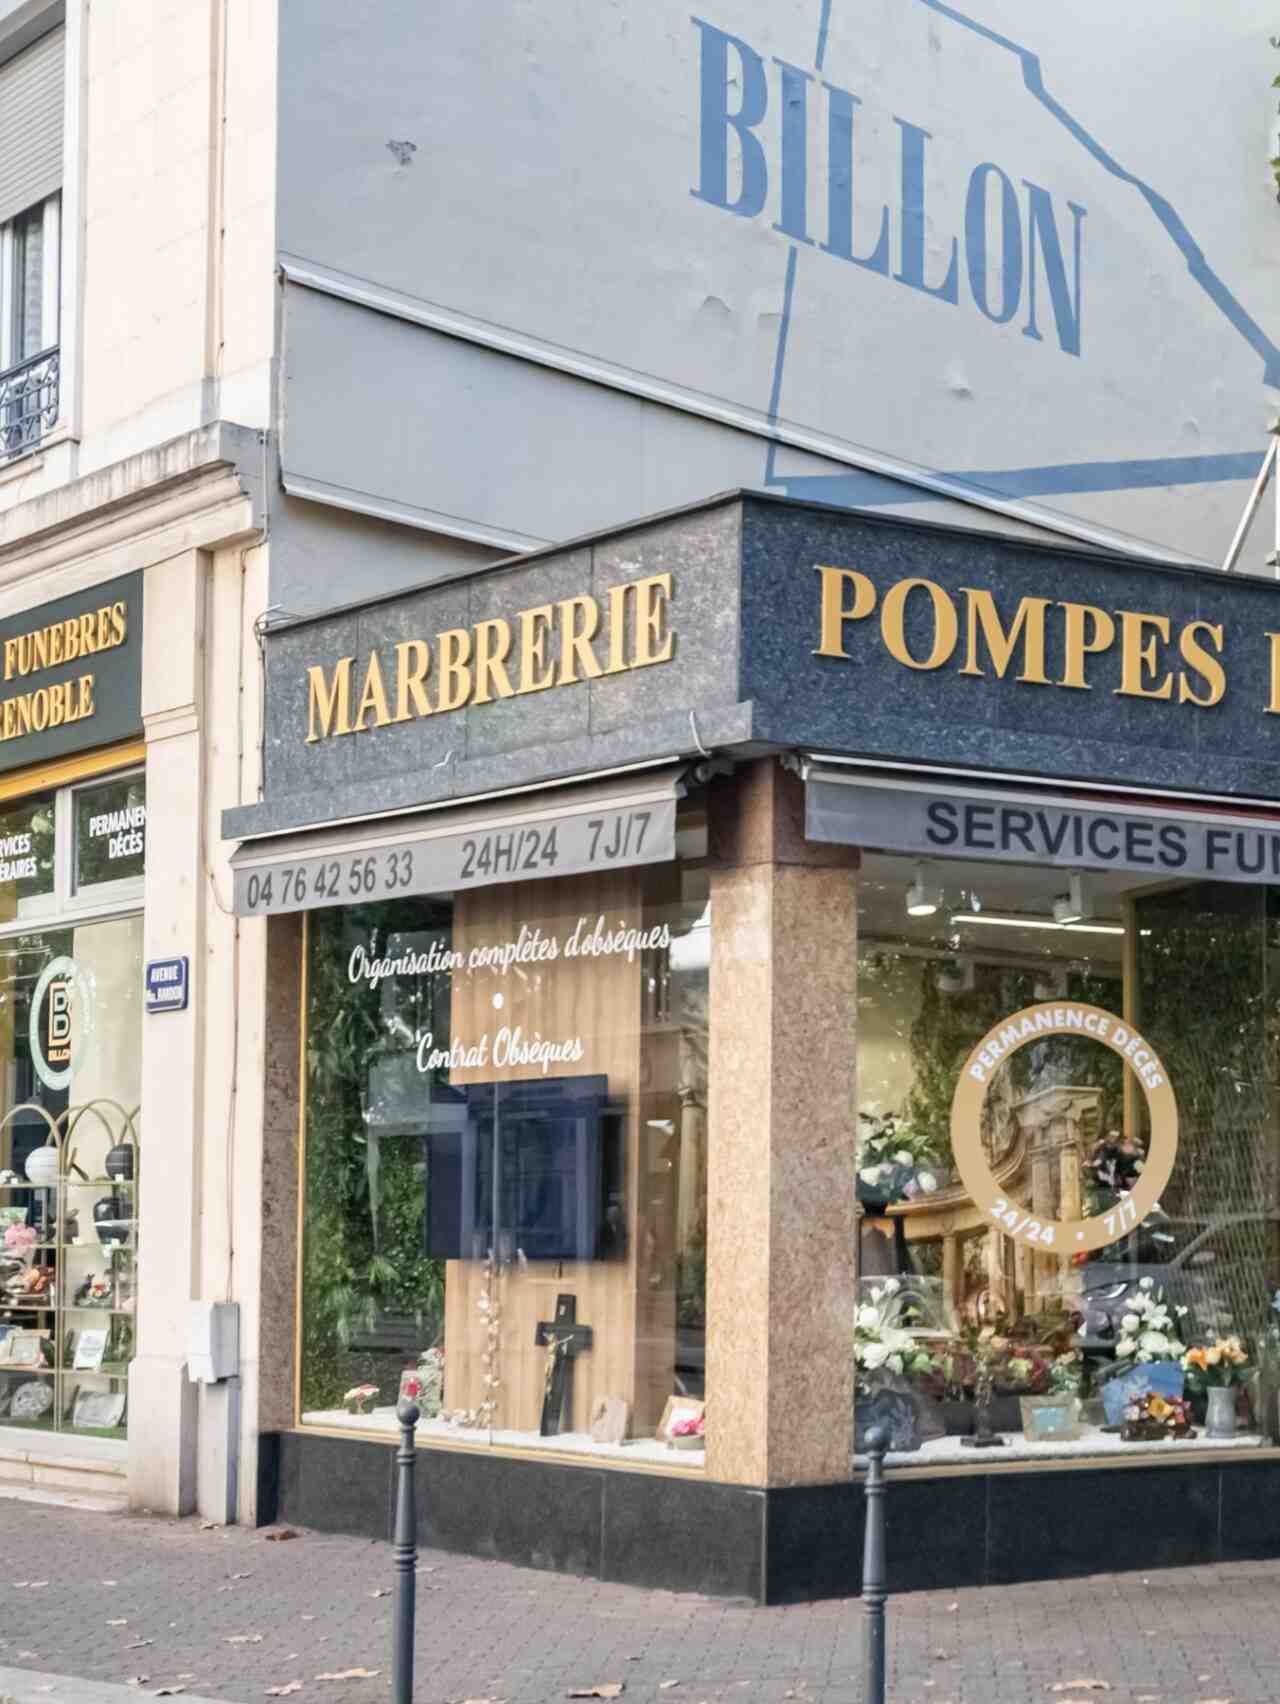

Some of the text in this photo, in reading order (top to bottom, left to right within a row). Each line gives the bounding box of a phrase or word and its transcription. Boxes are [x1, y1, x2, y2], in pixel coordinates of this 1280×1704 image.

[690, 16, 1087, 358] BILLON
[4, 601, 127, 681] FUNEBRES
[304, 573, 674, 744] MARBRERIE
[811, 565, 1227, 707] POMPES
[0, 674, 95, 742] ENOBLE
[248, 813, 651, 908] 04 76 42 56 33 24H/24 7J/7
[926, 801, 1188, 867] SERVICES
[349, 915, 671, 989] Organisation complètes d'obsèques
[416, 1025, 585, 1074] Contrat Obsèques
[969, 1008, 1111, 1083] PERMANENCE
[990, 1198, 1137, 1245] 24/24 7/7
